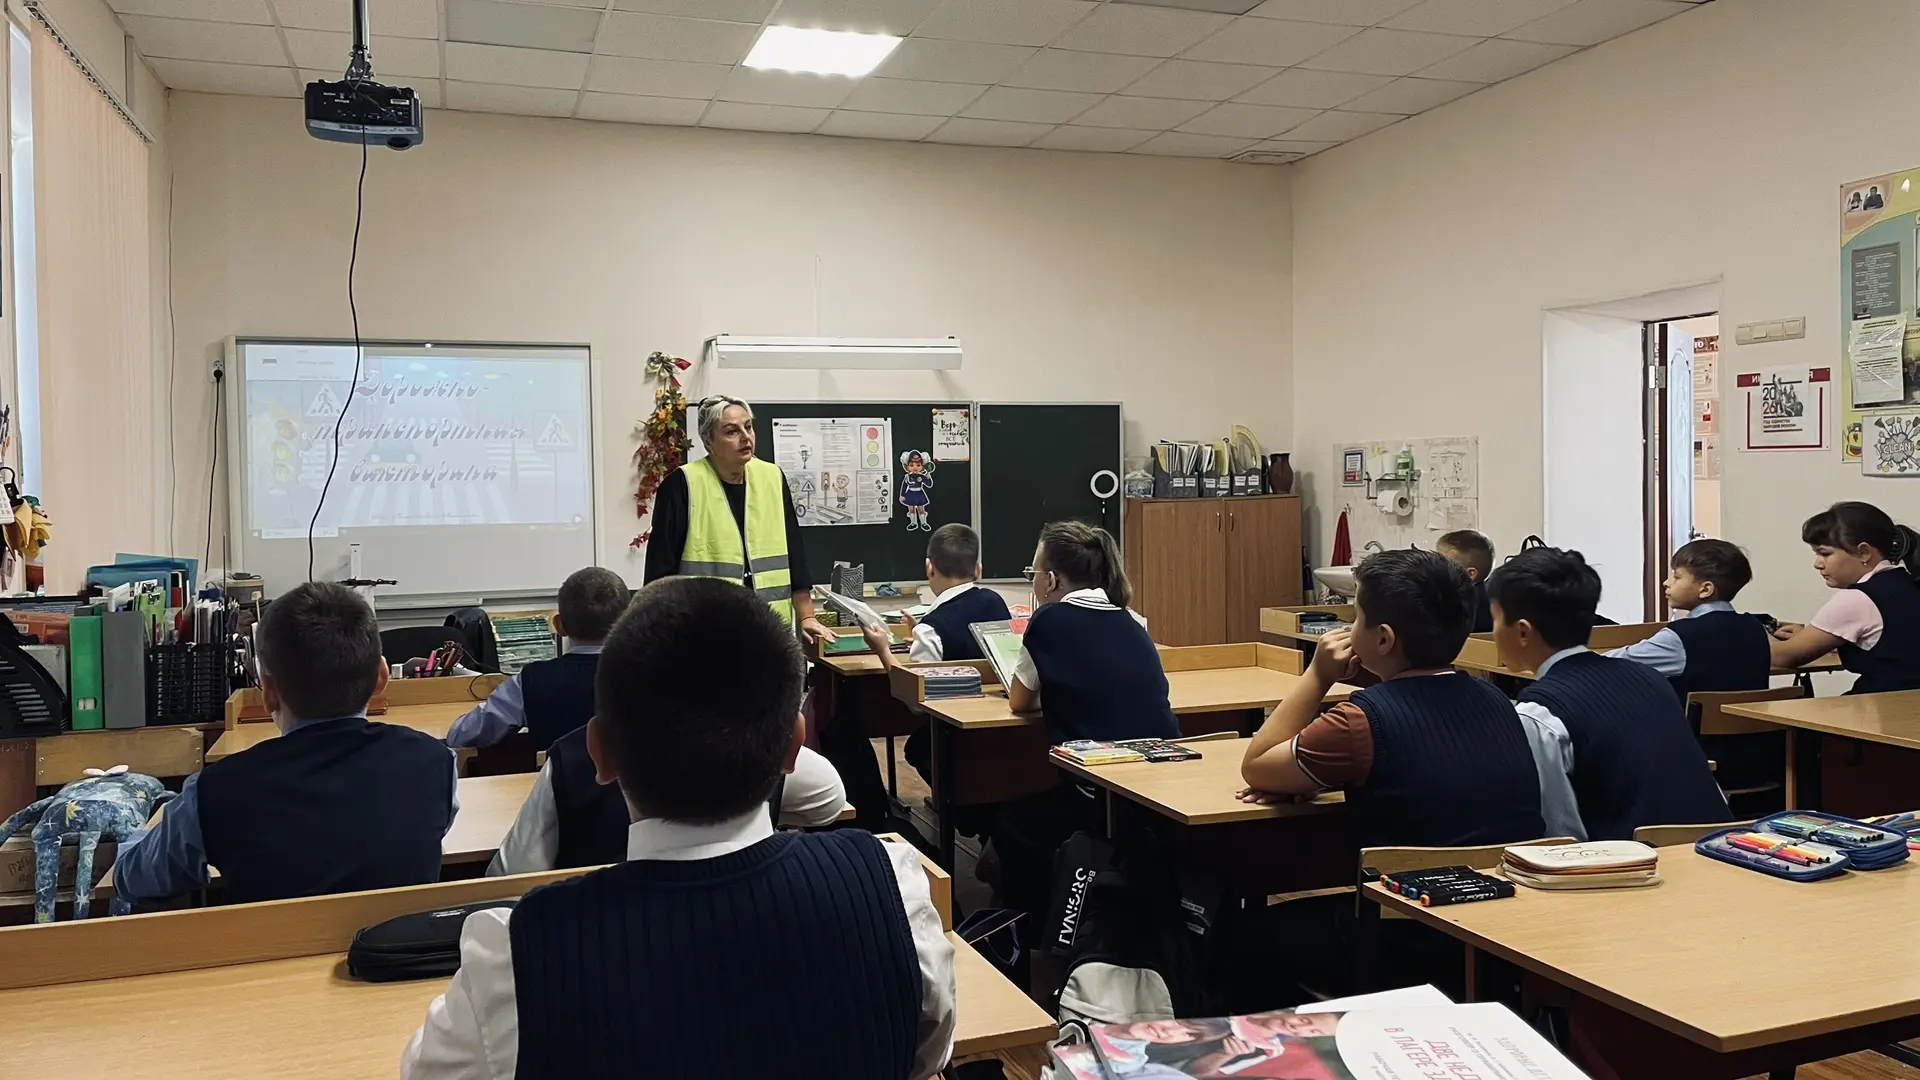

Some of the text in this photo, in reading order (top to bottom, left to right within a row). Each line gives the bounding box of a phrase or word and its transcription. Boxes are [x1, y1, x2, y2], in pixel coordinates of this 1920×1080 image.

[1763, 387, 1776, 400] 20
[1763, 402, 1776, 415] 26
[1883, 442, 1911, 454] CLEAN
[350, 459, 498, 489] викторина
[1390, 1035, 1439, 1069] ЛАГЕРЕ
[1423, 1039, 1459, 1059] ДВЕ
